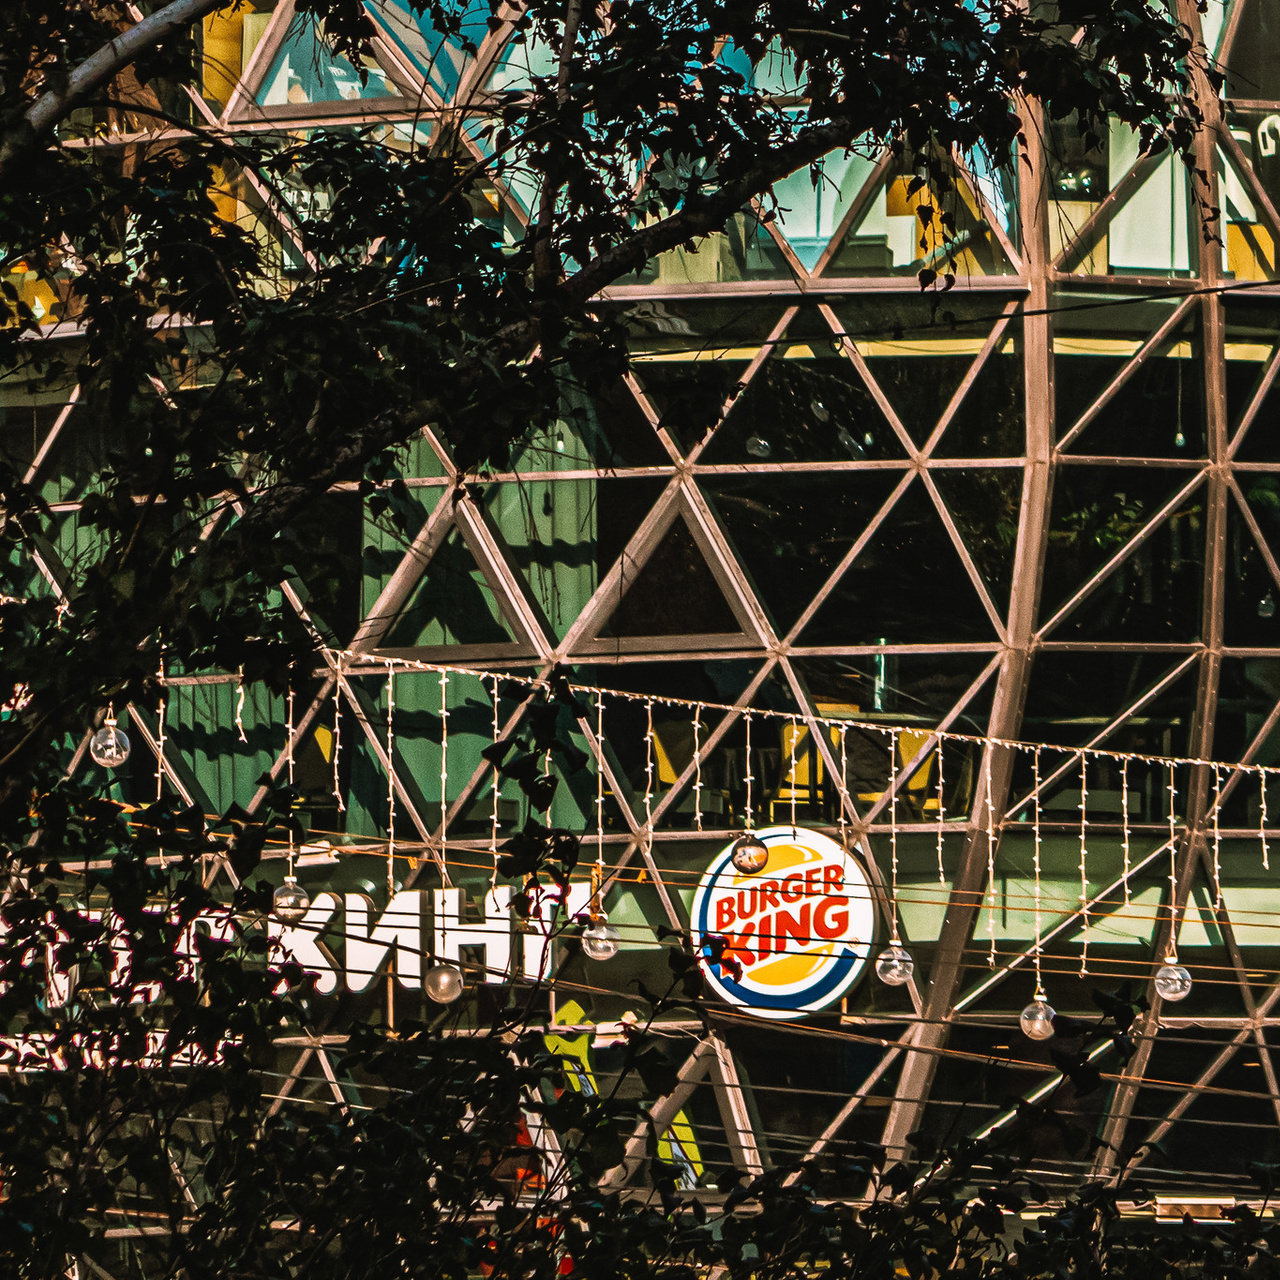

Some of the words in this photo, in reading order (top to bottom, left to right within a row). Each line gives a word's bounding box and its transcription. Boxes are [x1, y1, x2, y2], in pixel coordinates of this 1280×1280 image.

[267, 881, 592, 996] КИНГ
[715, 863, 845, 932] BURGER
[718, 896, 850, 979] KING
